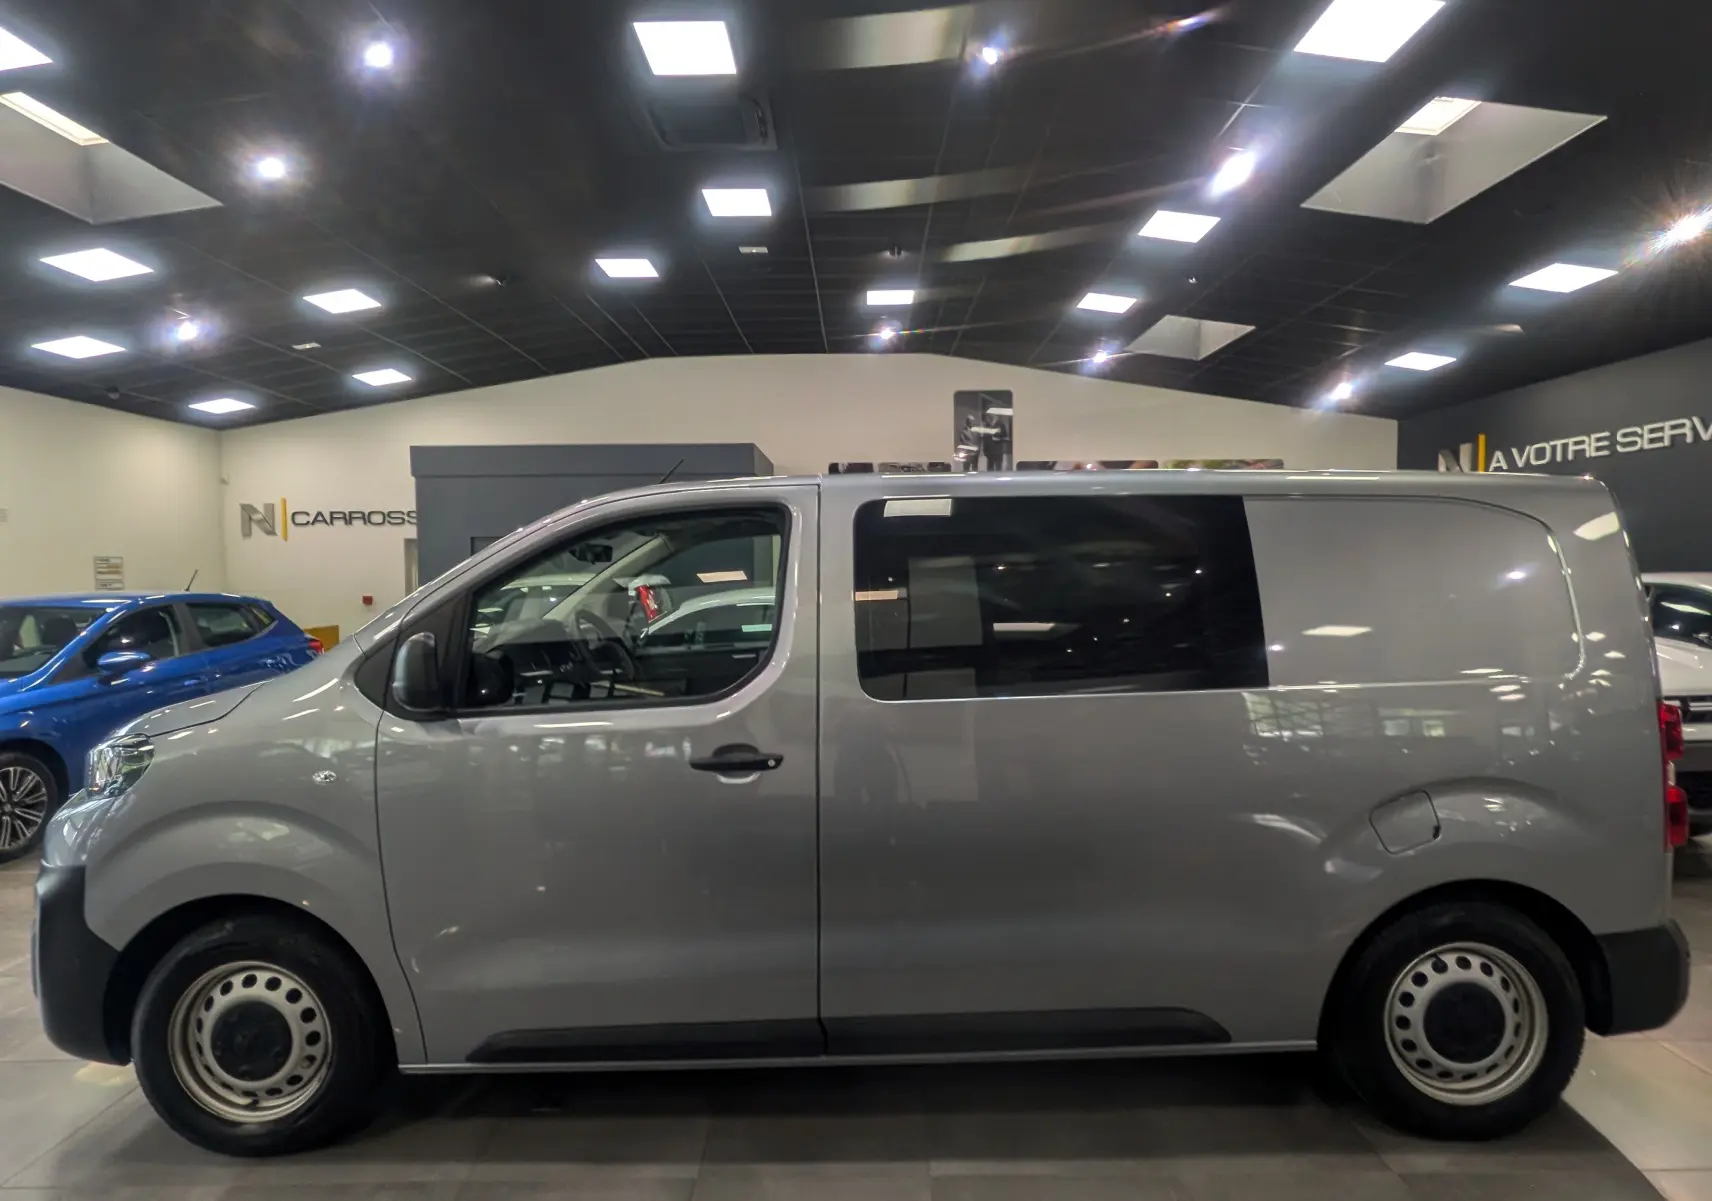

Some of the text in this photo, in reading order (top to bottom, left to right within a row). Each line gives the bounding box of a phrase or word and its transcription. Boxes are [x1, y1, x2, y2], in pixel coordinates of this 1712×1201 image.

[1489, 451, 1509, 472] A
[1511, 431, 1611, 468] VOTRE
[1616, 416, 1712, 453] SERV
